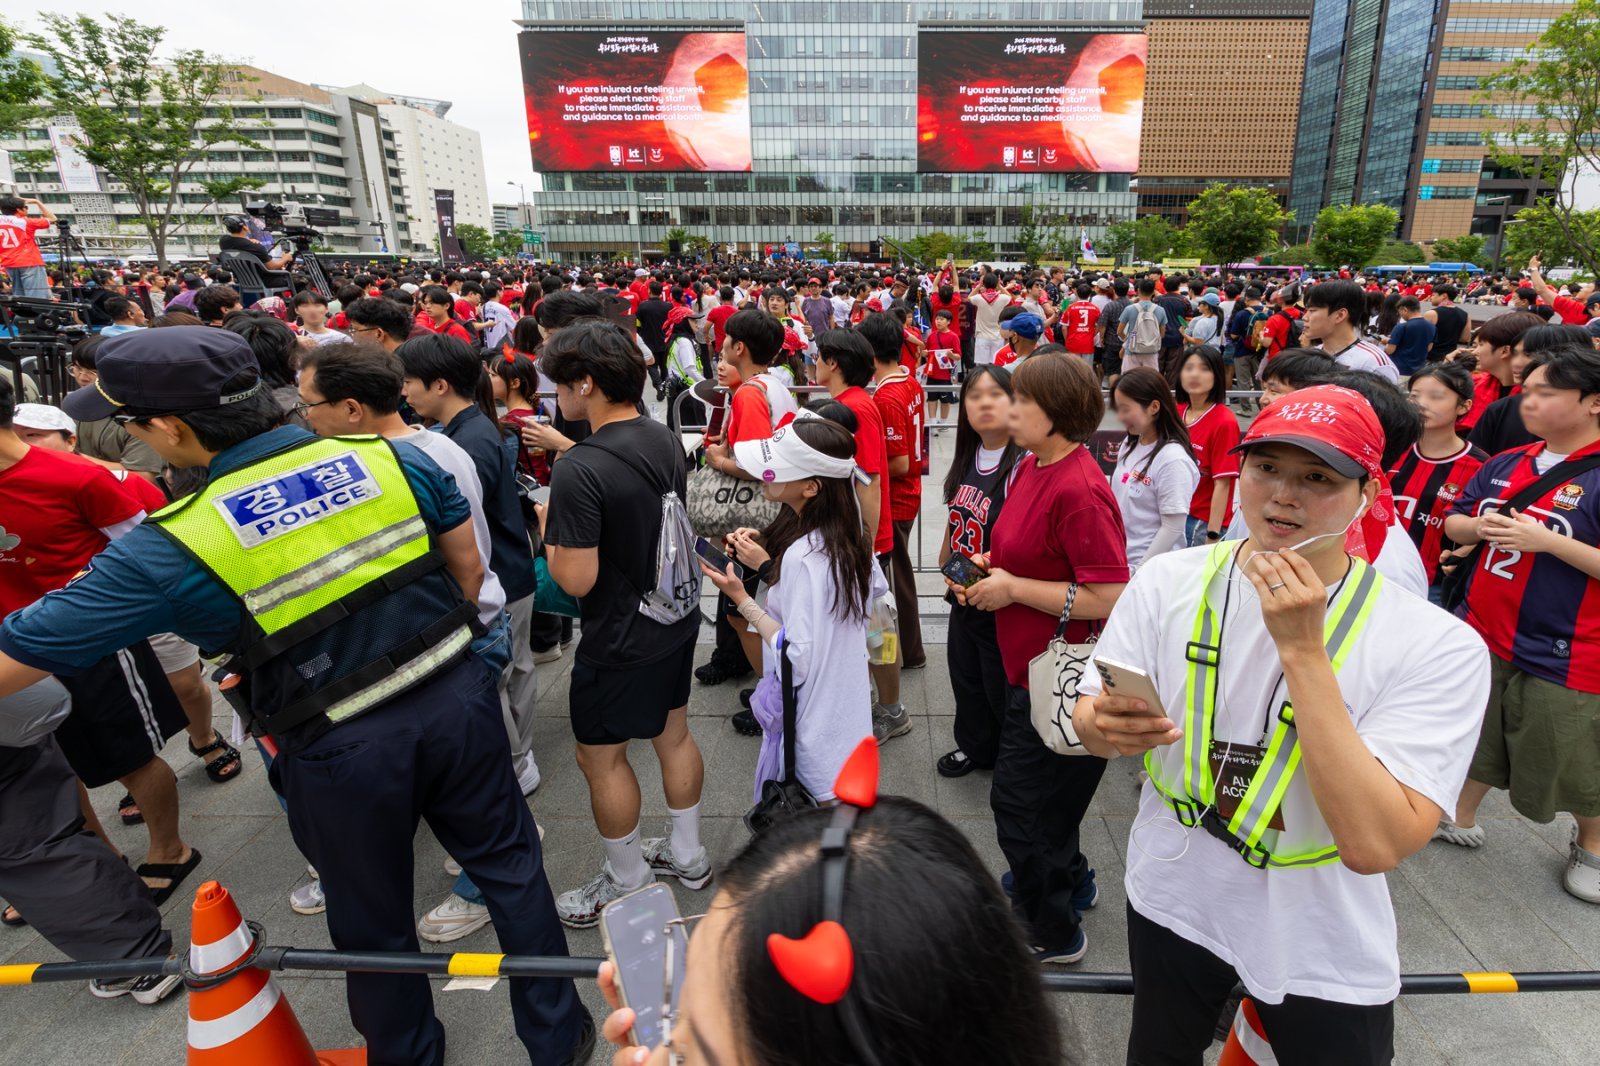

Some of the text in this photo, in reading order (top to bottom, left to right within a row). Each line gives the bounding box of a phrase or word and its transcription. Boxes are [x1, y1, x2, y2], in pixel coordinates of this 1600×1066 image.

[558, 85, 565, 94] If
[566, 86, 583, 95] you
[584, 86, 599, 94] are
[600, 85, 632, 94] injured
[633, 86, 643, 94] or
[643, 85, 675, 95] feeling
[959, 86, 966, 94] If
[967, 87, 984, 96] you
[1002, 86, 1034, 95] injured
[1034, 87, 1044, 95] or
[1045, 86, 1076, 96] feeling
[579, 95, 608, 104] please
[632, 95, 664, 104] nearby
[979, 96, 1008, 104] please
[1032, 96, 1064, 104] nearby
[564, 104, 703, 112] to receive immediate assistance
[1008, 105, 1054, 113] immediate
[1055, 105, 1102, 113] assistance
[563, 113, 580, 121] and
[581, 113, 623, 122] guidance
[623, 113, 634, 121] to
[641, 113, 677, 121] medical
[960, 114, 979, 122] and
[979, 114, 1021, 123] guidance
[1022, 114, 1033, 122] to
[1040, 114, 1075, 122] medical
[628, 148, 640, 158] kt
[1022, 149, 1034, 159] kt
[0, 227, 20, 248] 21
[1078, 309, 1089, 327] 3
[1276, 402, 1310, 418] 우리
[714, 479, 754, 504] alo
[1552, 489, 1581, 506] Seoul
[255, 485, 366, 536] POLICE
[949, 508, 984, 559] 23
[1483, 540, 1522, 580] 12
[1222, 785, 1247, 798] ACC
